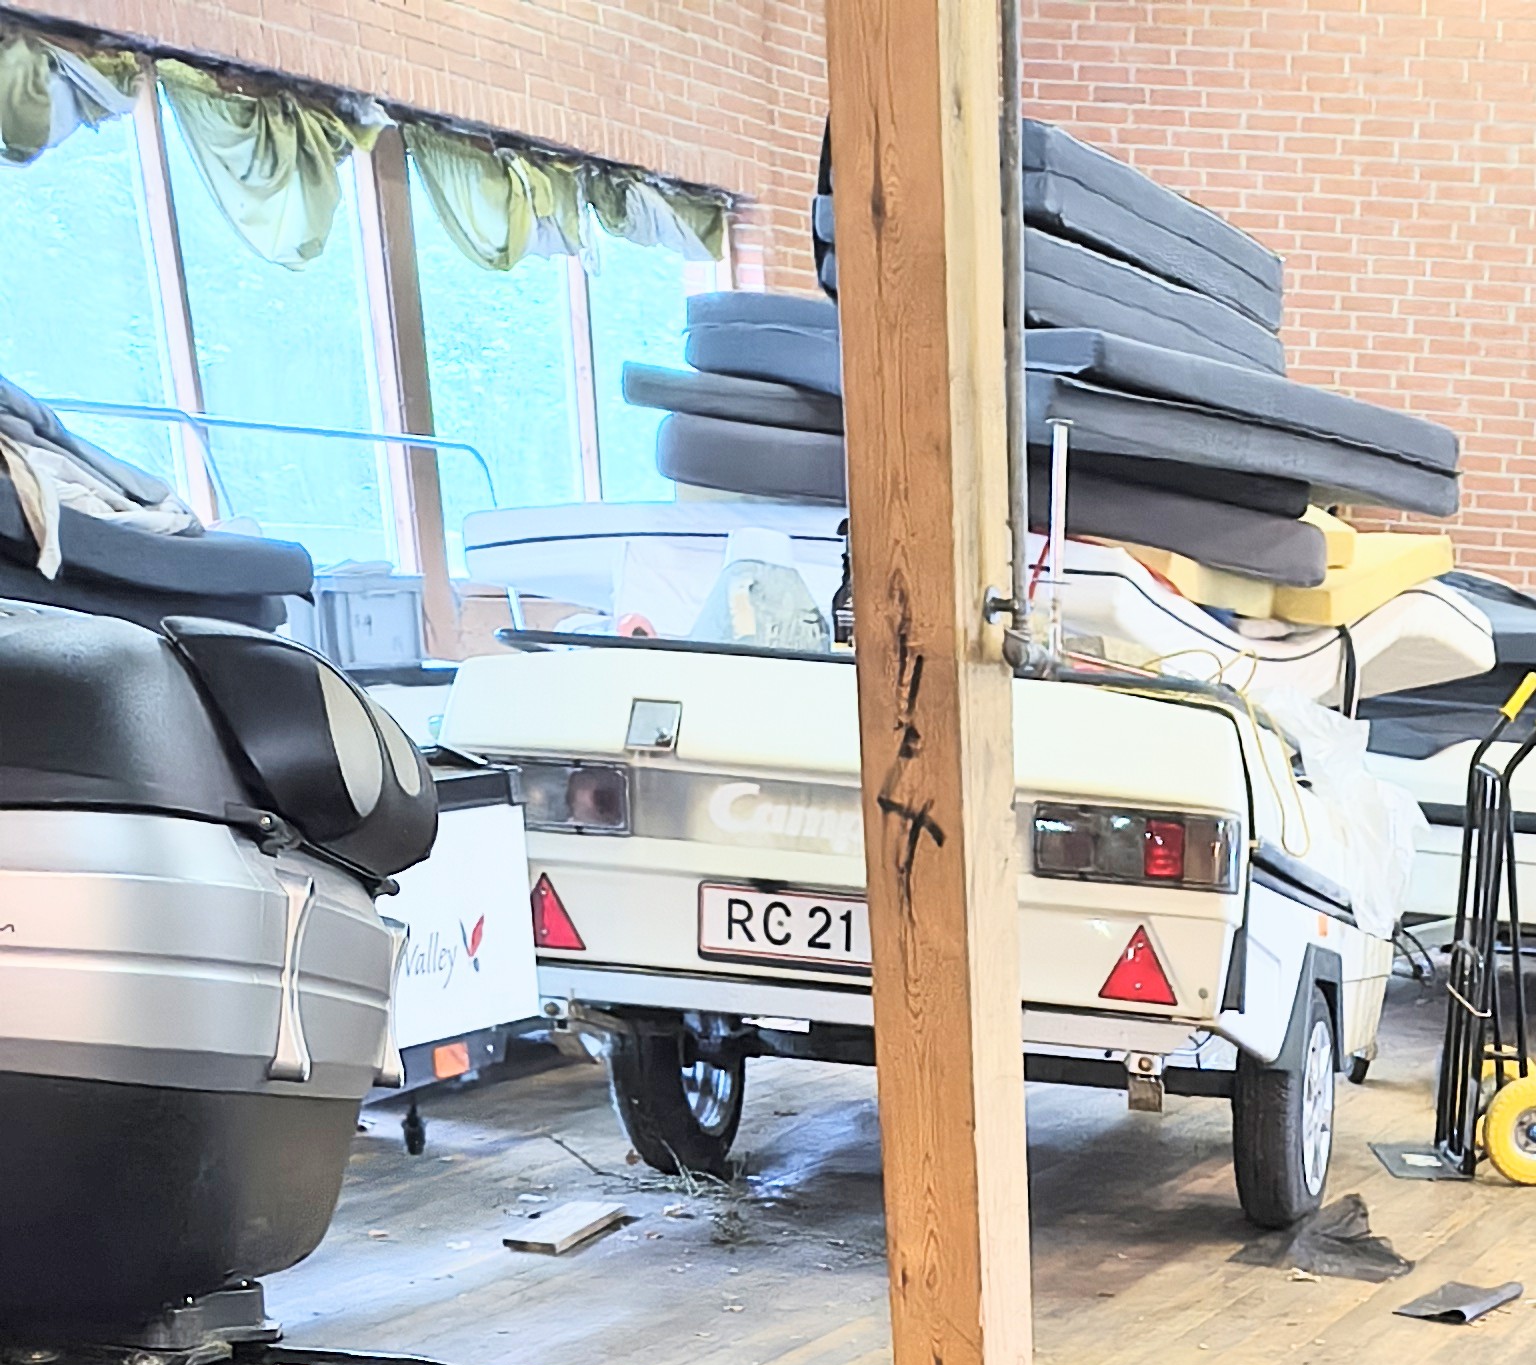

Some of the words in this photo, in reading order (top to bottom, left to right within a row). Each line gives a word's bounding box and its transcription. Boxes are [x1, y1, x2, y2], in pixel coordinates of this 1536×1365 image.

[727, 898, 791, 946] RC
[807, 906, 852, 952] 21
[405, 931, 457, 989] Valley
